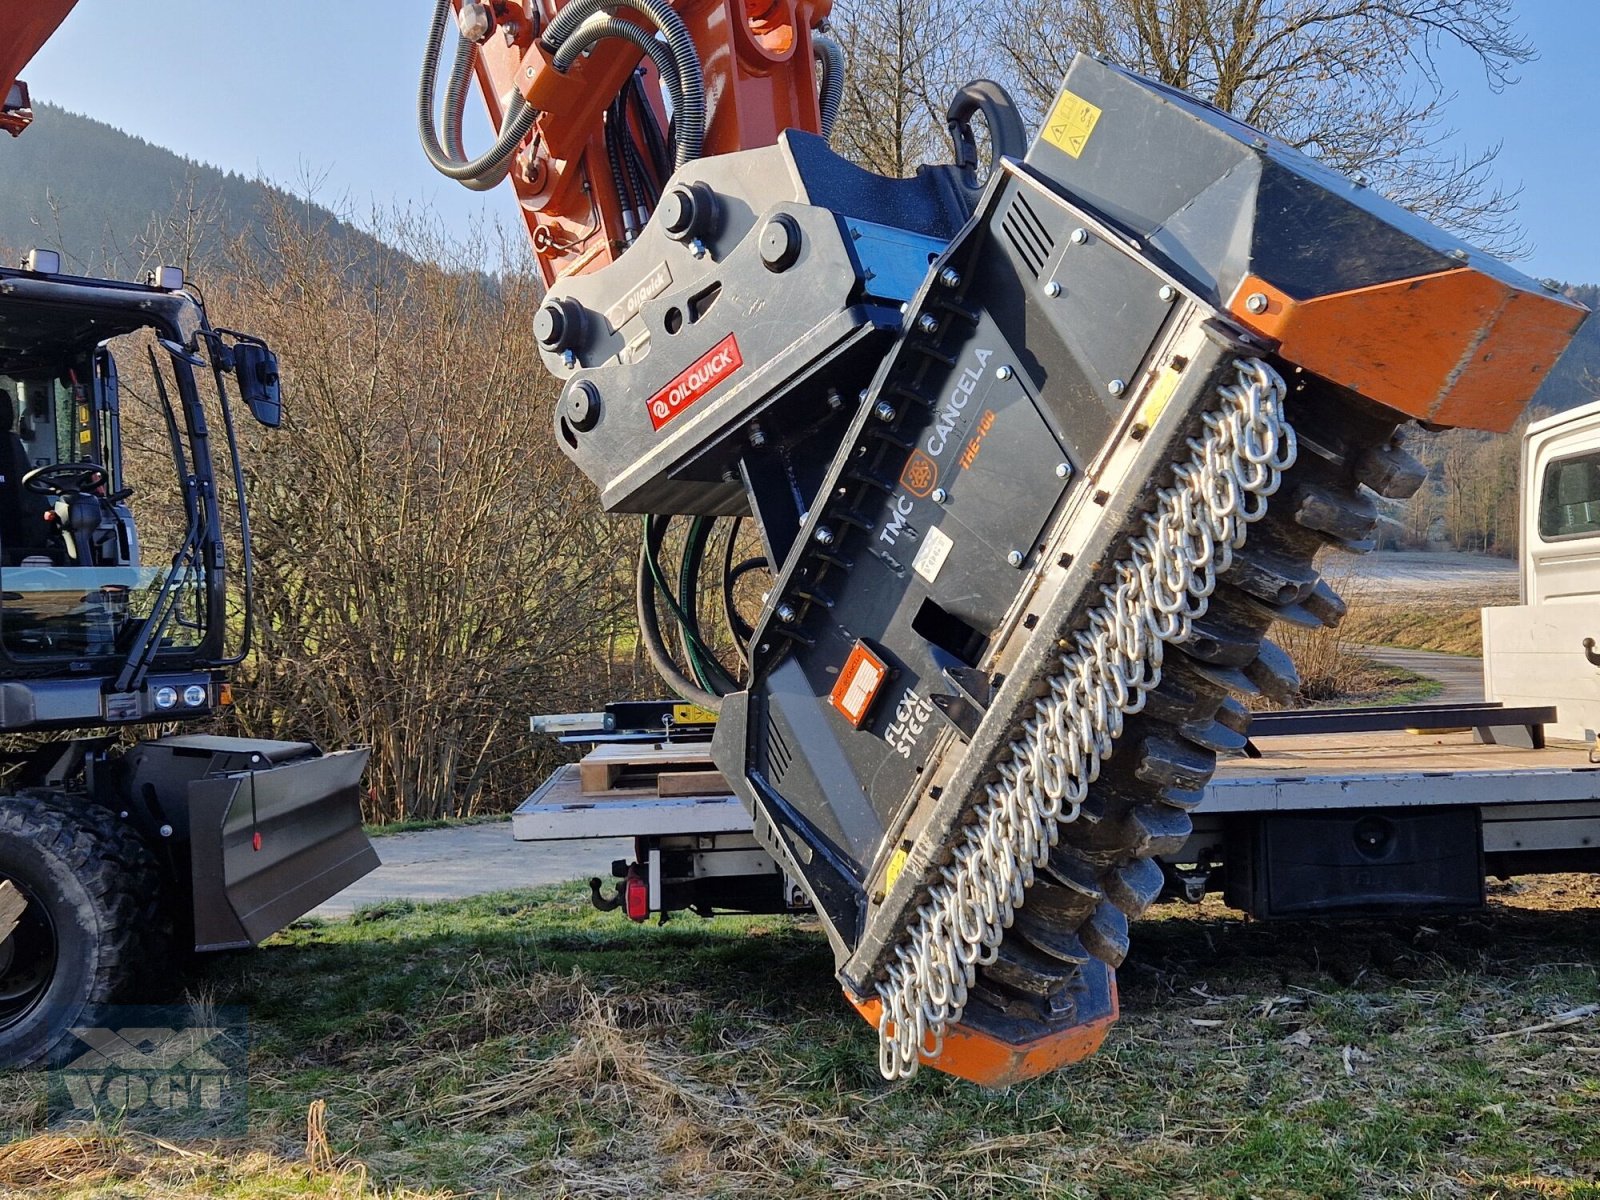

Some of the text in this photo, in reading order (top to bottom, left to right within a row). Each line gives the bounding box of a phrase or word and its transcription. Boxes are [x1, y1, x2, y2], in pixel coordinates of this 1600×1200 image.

[668, 348, 733, 405] OILQUICK
[879, 348, 994, 546] TMC CANCELA
[884, 687, 920, 747] FLEXI
